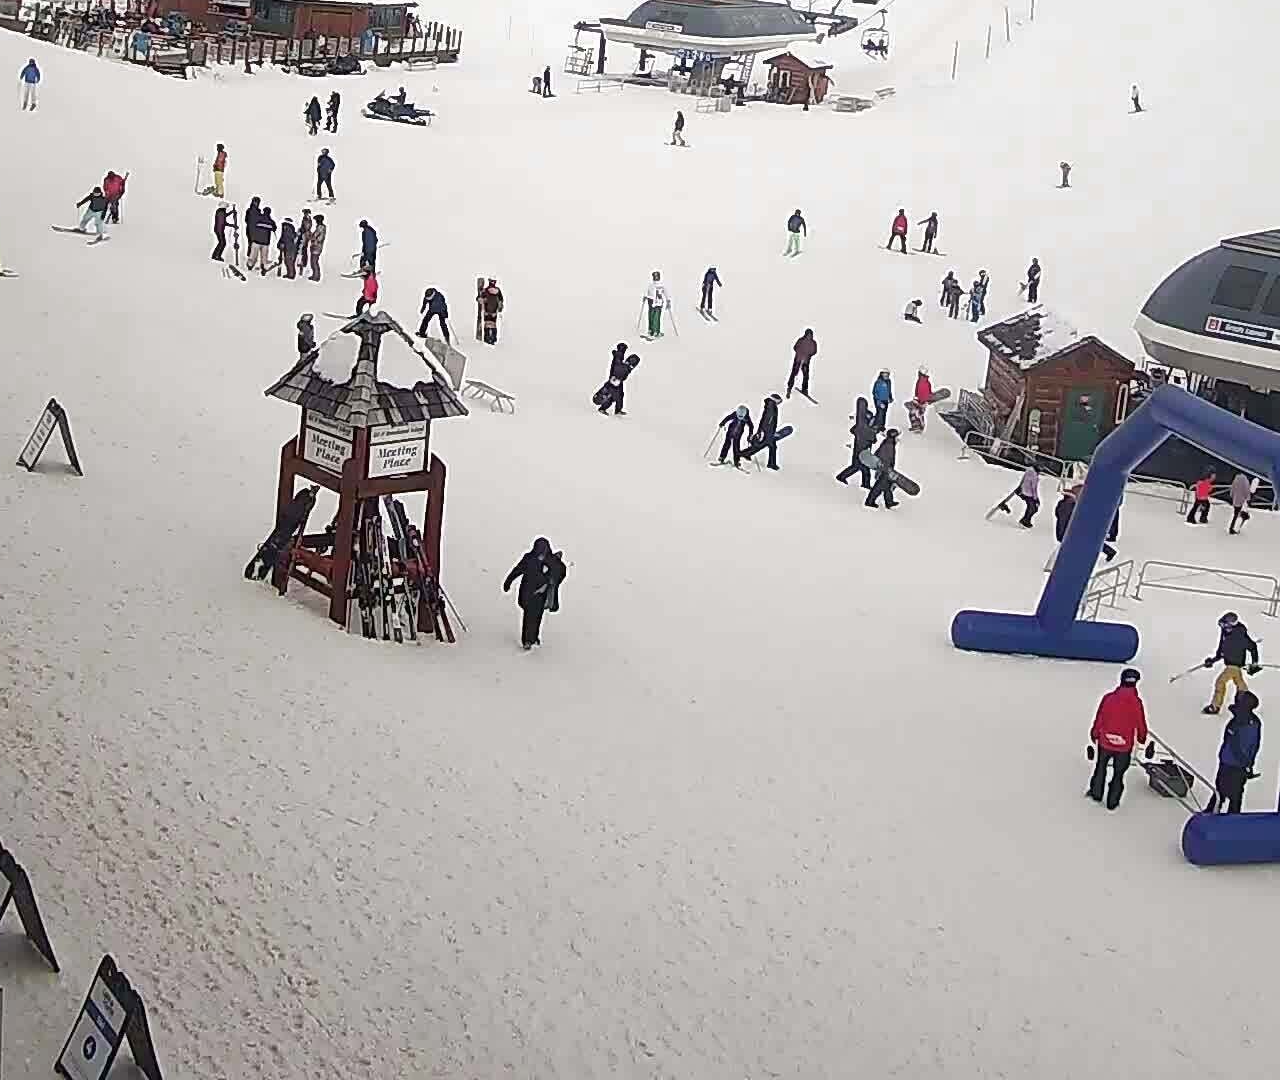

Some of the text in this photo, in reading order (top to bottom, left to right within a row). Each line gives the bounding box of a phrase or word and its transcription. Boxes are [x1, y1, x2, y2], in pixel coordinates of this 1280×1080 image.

[312, 433, 346, 456] Meeting
[377, 445, 418, 459] Meeting
[382, 457, 412, 469] Place
